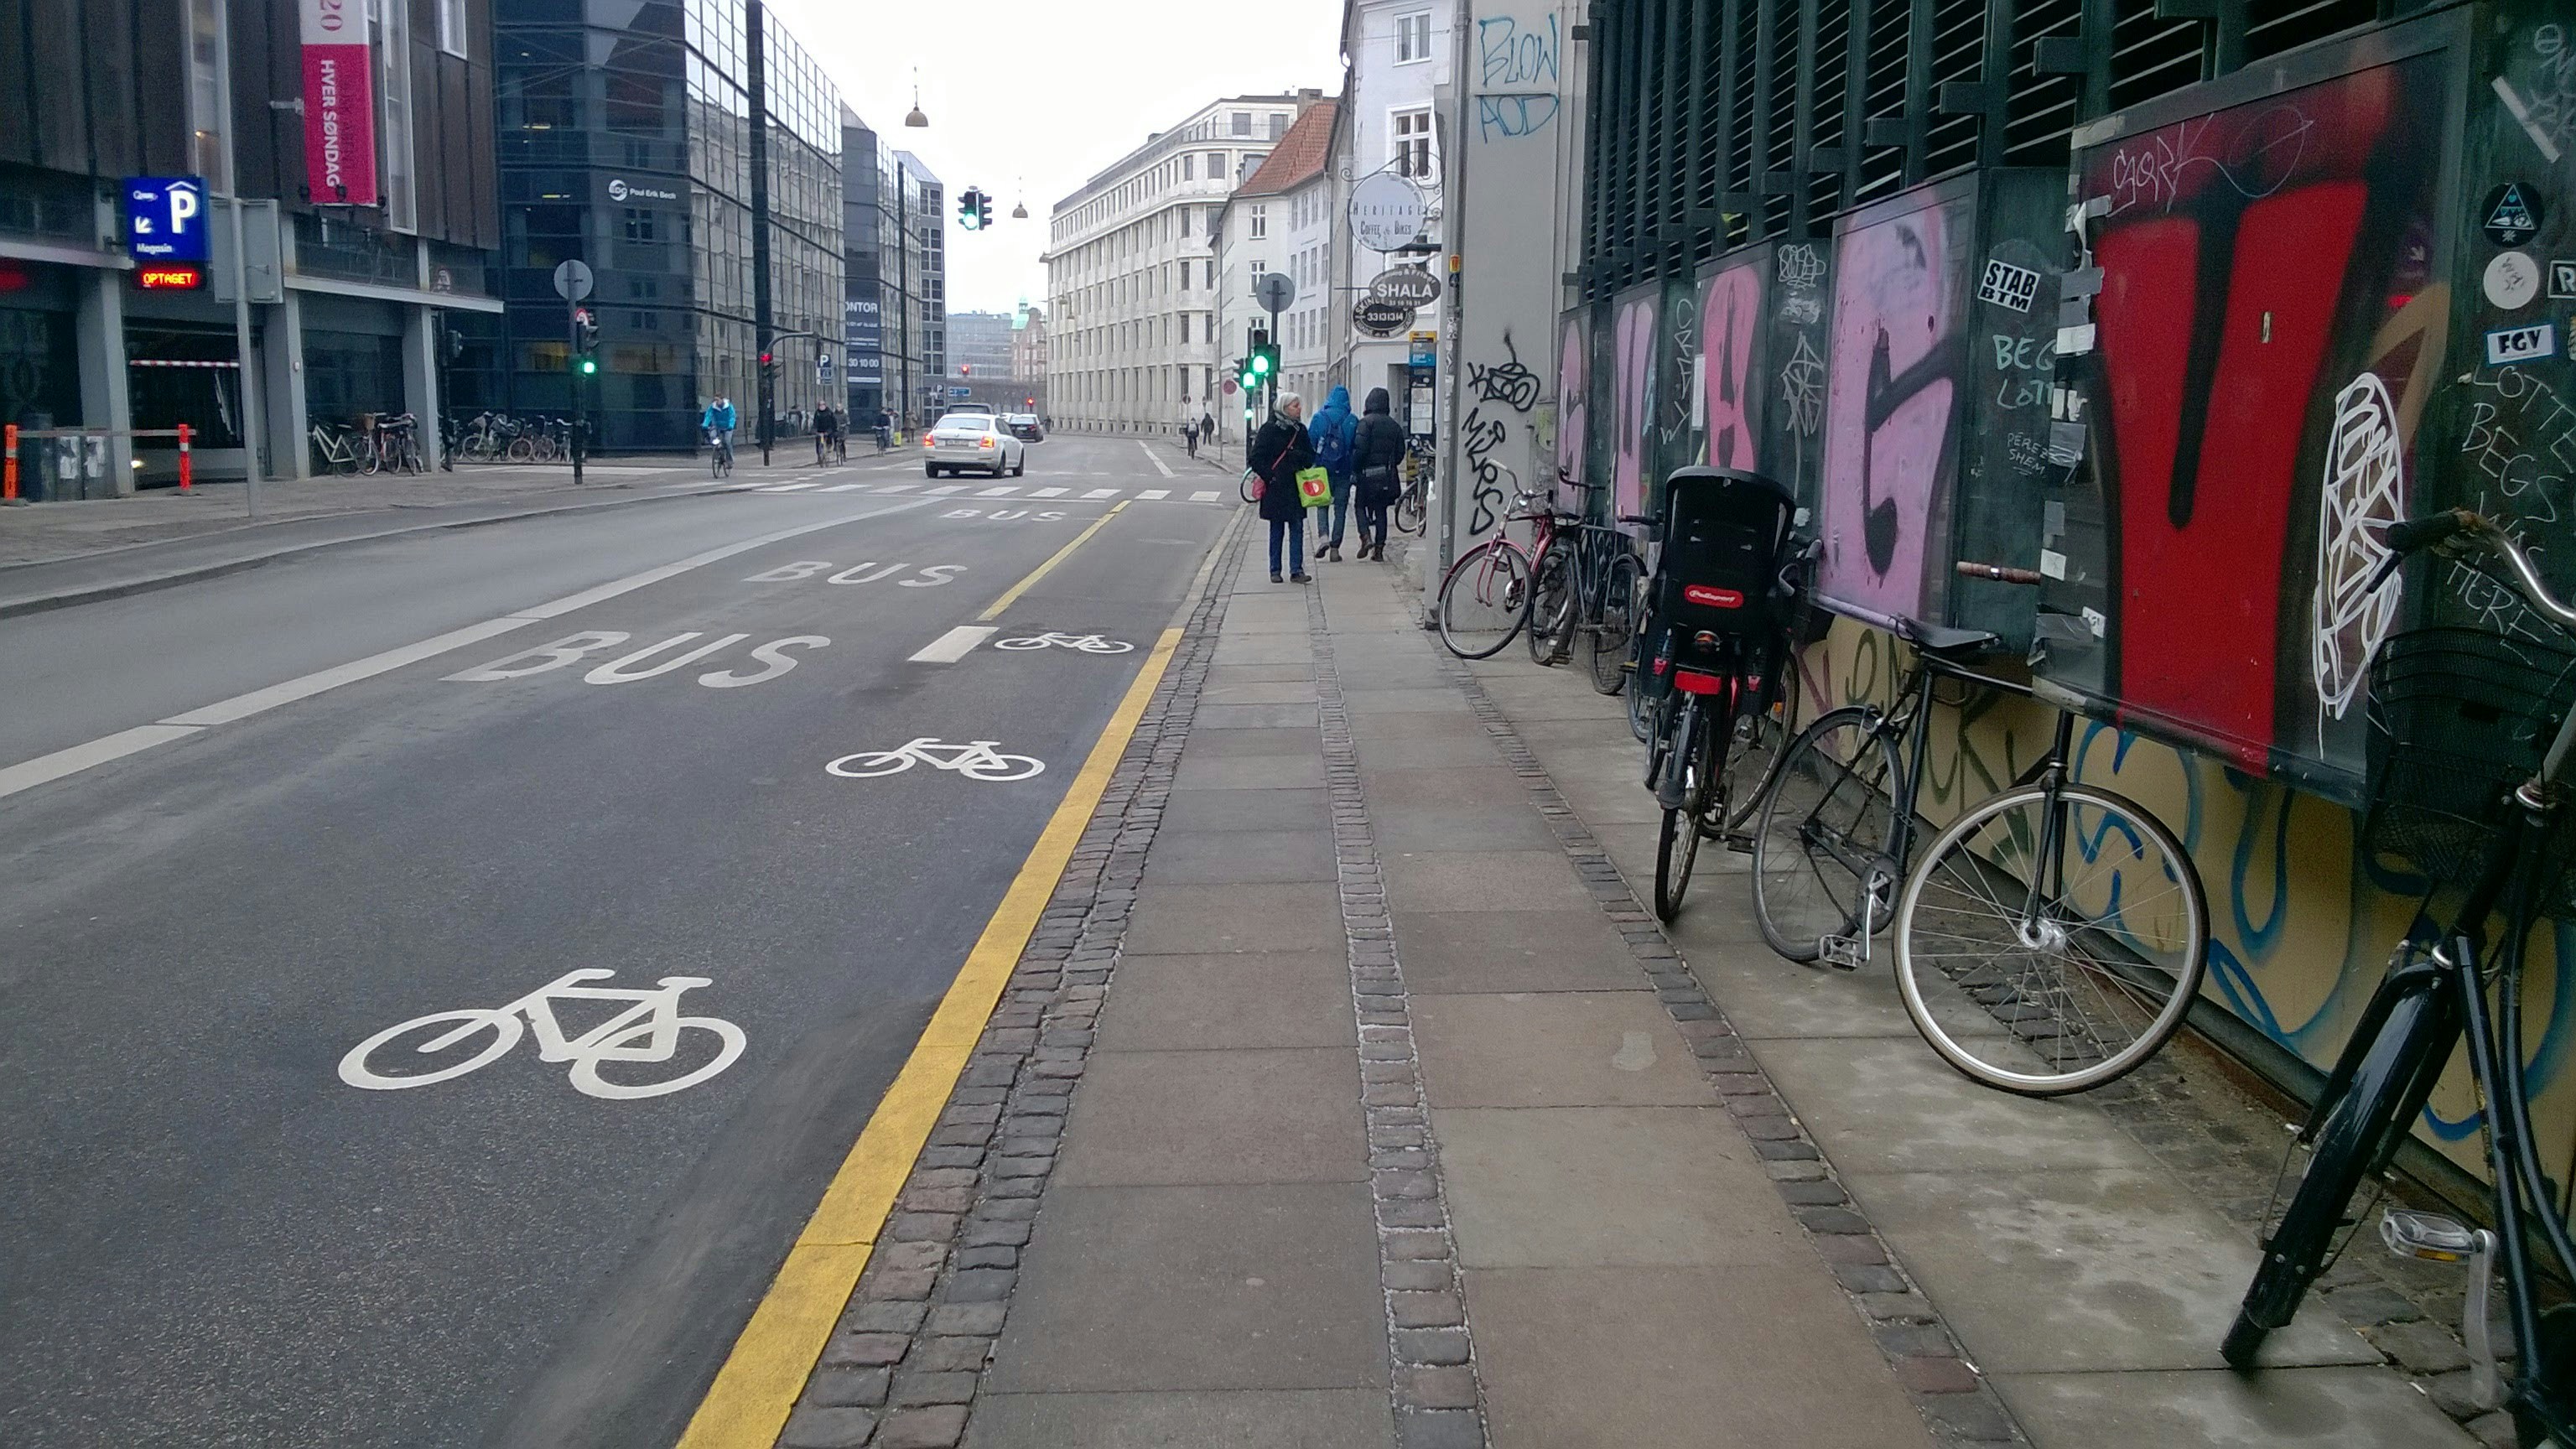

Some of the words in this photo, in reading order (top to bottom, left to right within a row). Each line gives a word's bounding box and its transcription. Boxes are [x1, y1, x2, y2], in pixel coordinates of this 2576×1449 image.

[1478, 13, 1557, 88] BLOW
[320, 59, 336, 108] HVER
[323, 112, 340, 188] SØNDAG
[169, 190, 197, 234] P
[137, 242, 173, 255] Magasin
[1376, 283, 1433, 298] SHALA
[1985, 262, 2037, 297] STAB
[1979, 285, 2030, 310] BTM
[2498, 328, 2542, 354] FGV
[938, 509, 1066, 522] BUS
[742, 561, 968, 588] BUS
[438, 630, 832, 689] BUS
